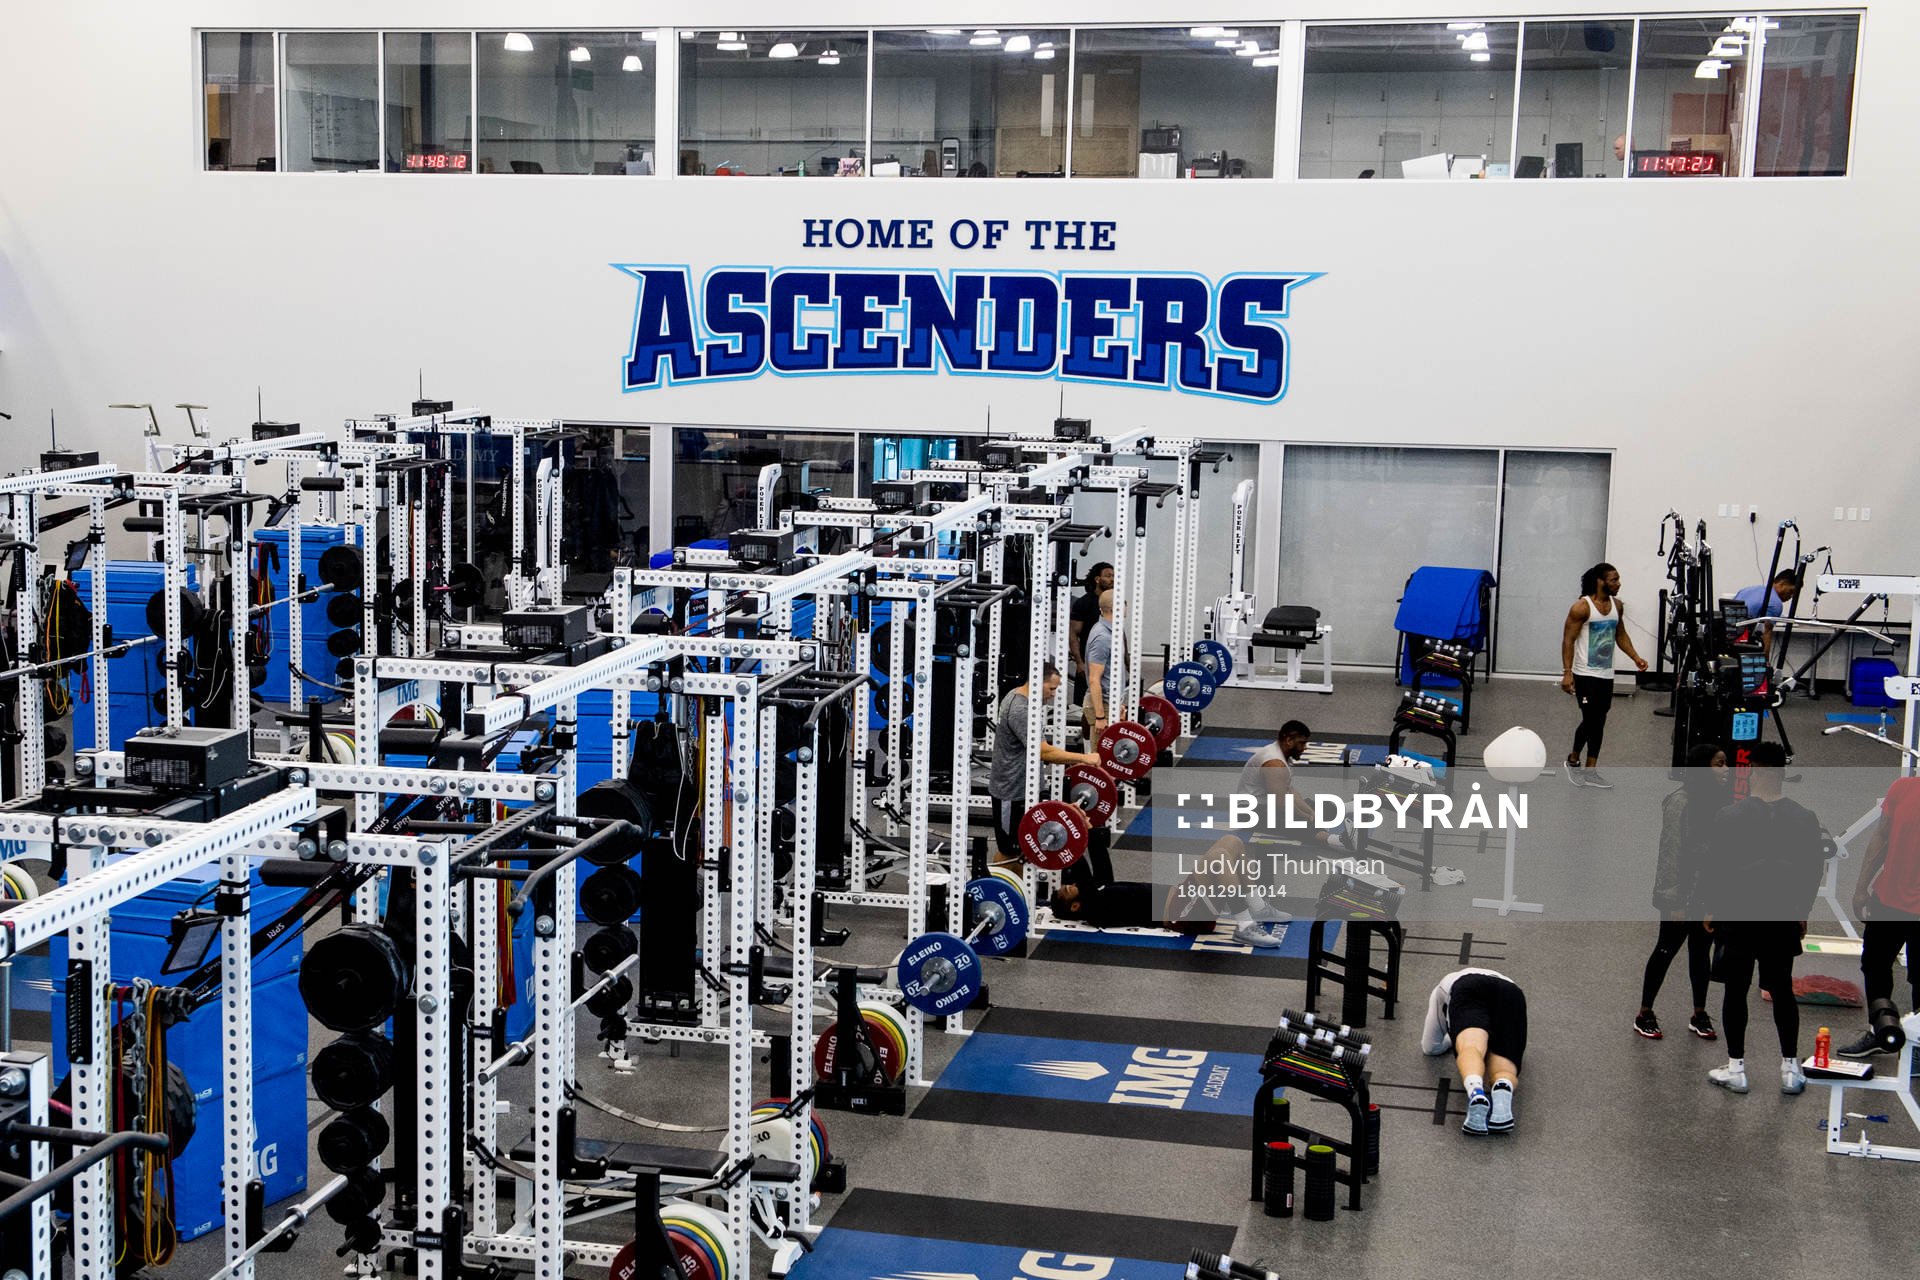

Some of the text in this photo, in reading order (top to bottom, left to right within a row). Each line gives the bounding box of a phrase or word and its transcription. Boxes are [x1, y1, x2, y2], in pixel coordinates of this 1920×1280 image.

[1642, 156, 1714, 171] 11:47:21
[802, 218, 1117, 251] HOME OF THE
[609, 263, 1328, 405] ASCENDERS
[641, 587, 656, 609] IMG
[1216, 649, 1227, 673] ELEIKO
[1178, 667, 1203, 677] ELEIKO
[396, 680, 419, 707] IMG
[1166, 681, 1177, 690] 20
[1175, 698, 1200, 707] ELEIKO
[1101, 738, 1114, 748] 25
[1119, 727, 1146, 743] ELEIKO
[1106, 759, 1134, 776] ELEIKO
[1140, 754, 1151, 764] 25
[1078, 770, 1107, 789] ELEIKO
[1733, 748, 1752, 803] ISER
[1098, 801, 1111, 812] 25
[372, 816, 390, 834] SPRI
[1032, 809, 1047, 824] 25
[1058, 810, 1081, 839] ELEIKO
[0, 840, 27, 861] MG
[1024, 833, 1047, 862] ELEIKO
[1059, 848, 1073, 863] 25
[970, 886, 984, 901] 20
[998, 891, 1021, 925] ELEIKO
[266, 922, 285, 939] SPRI
[1191, 917, 1254, 954] IM
[994, 934, 1007, 949] 20
[907, 941, 942, 967] ELEIKO
[954, 954, 971, 969] 20
[935, 984, 970, 1009] ELEIKO
[823, 1035, 838, 1074] ELEIKO
[1107, 1046, 1209, 1110] IMG
[1201, 1064, 1231, 1100] ACADEMY
